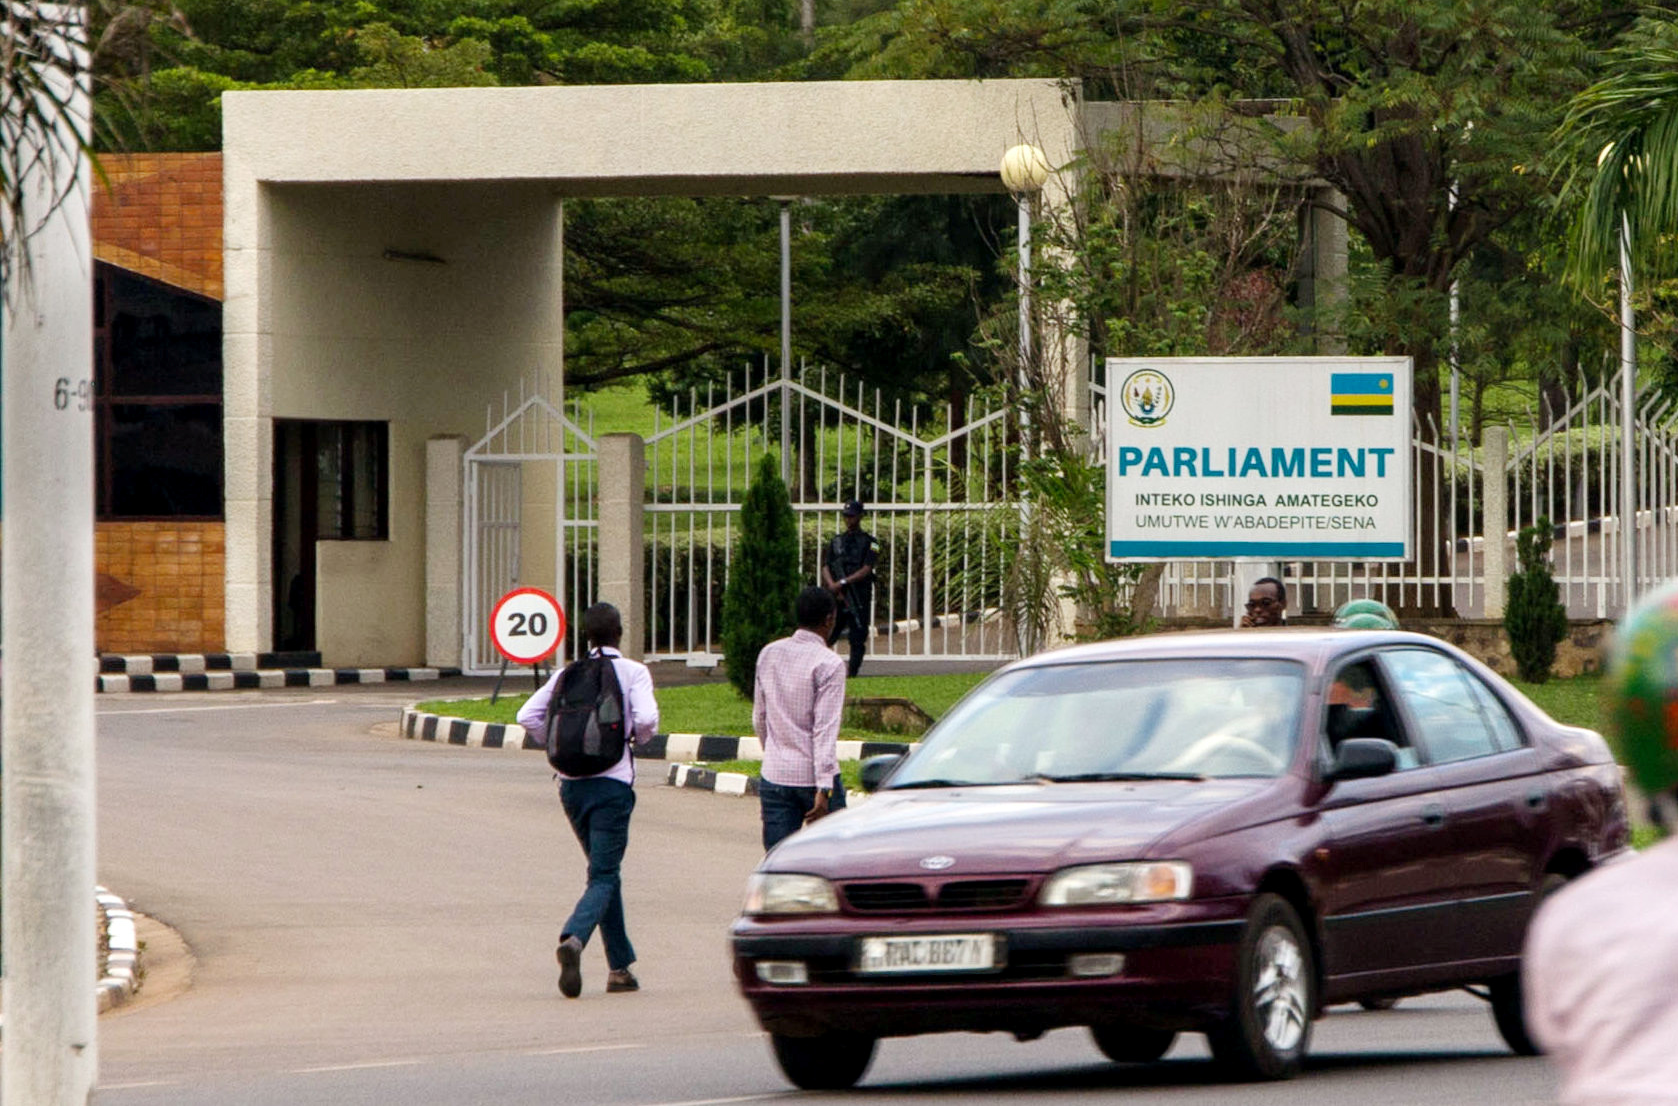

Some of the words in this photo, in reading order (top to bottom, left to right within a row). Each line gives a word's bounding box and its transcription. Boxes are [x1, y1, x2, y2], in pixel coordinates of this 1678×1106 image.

[1118, 446, 1395, 478] PARLIAMENT
[1135, 493, 1196, 507] INTEKO
[1200, 493, 1267, 507] ISHINGA
[1275, 494, 1379, 507] AMATEGEKO
[1136, 514, 1209, 528] UMUTWE
[1214, 515, 1376, 530] W'ABADEPITE/SENA
[507, 612, 548, 637] 20
